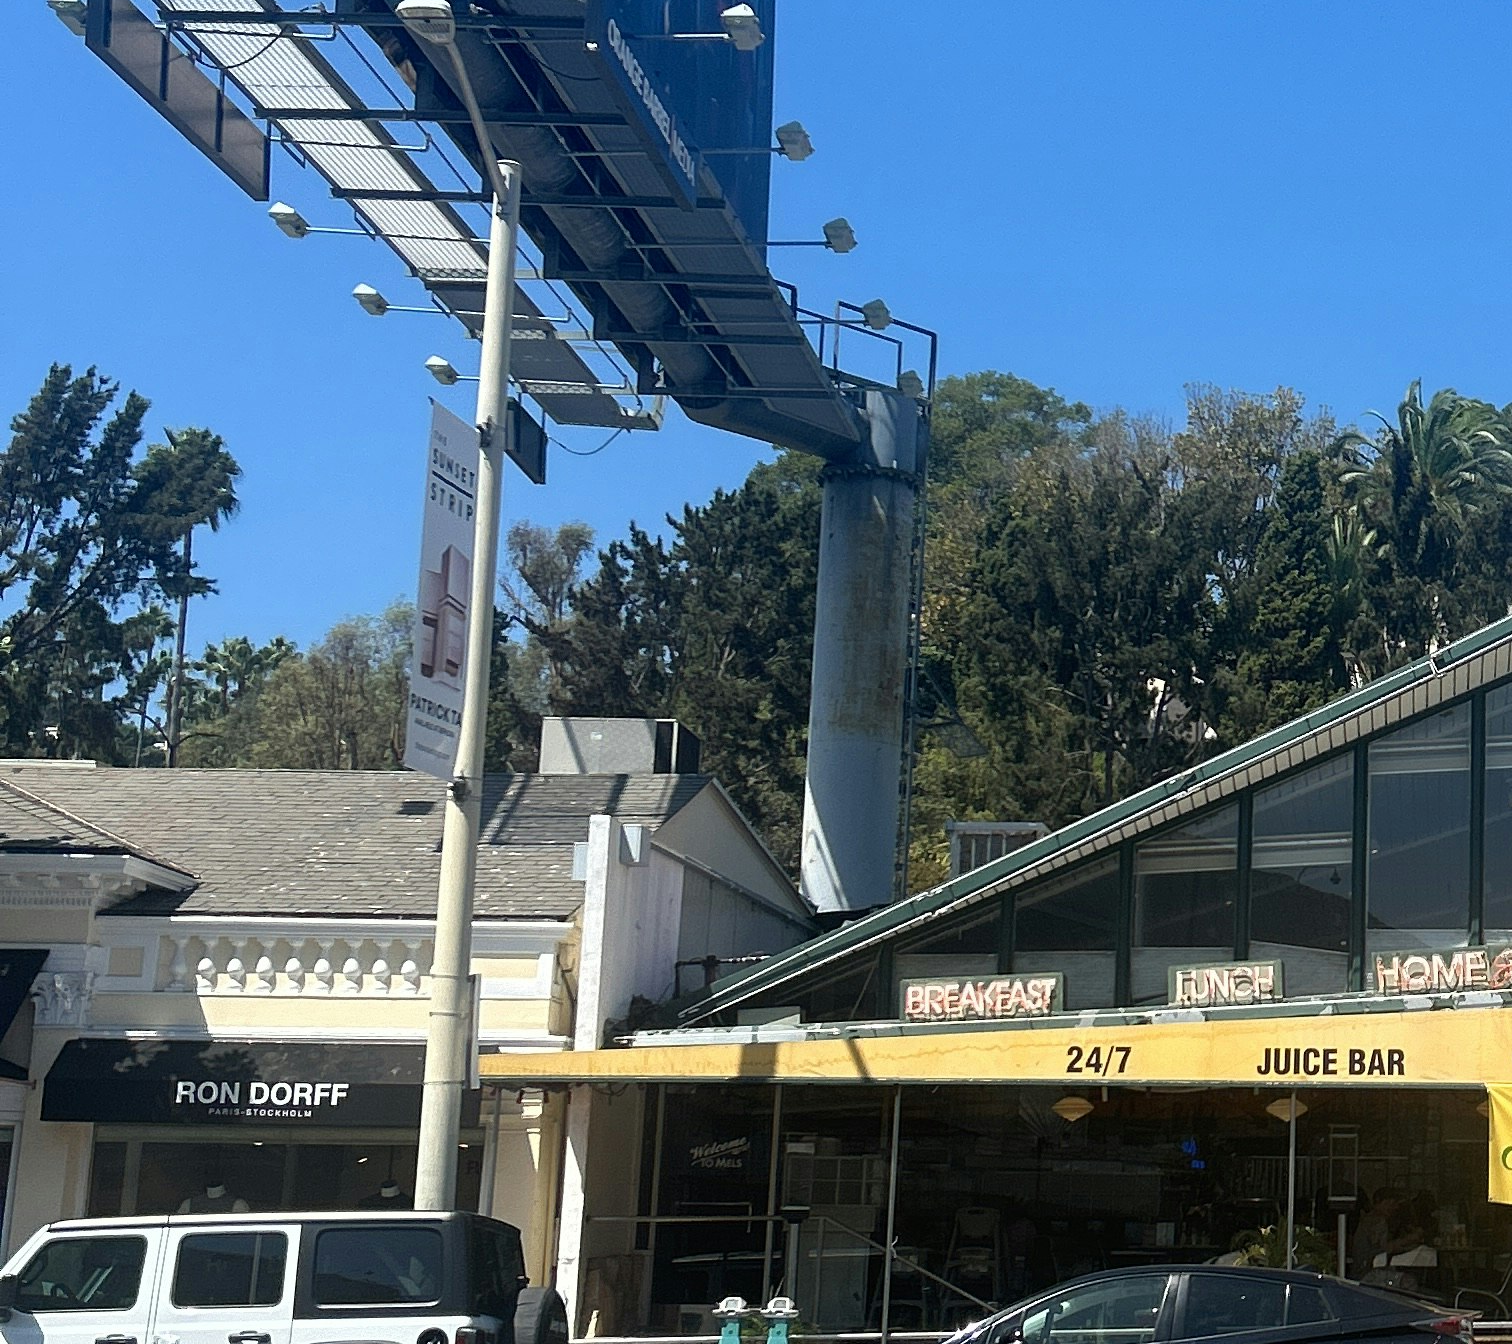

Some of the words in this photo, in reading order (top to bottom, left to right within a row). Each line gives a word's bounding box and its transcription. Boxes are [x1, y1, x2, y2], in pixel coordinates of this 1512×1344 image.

[433, 448, 475, 488] SUNSET
[430, 482, 474, 521] STRIP
[1175, 966, 1275, 1004] LUNCH
[1376, 950, 1488, 994] HOME
[905, 977, 1057, 1020] BREAKFAST
[1066, 1046, 1133, 1074] 24/7
[1257, 1048, 1338, 1075] JUICE
[1348, 1049, 1405, 1076] BAR
[175, 1081, 241, 1104] RON
[249, 1082, 350, 1106] DORFF
[690, 1137, 748, 1159] Welcome
[701, 1158, 714, 1168] TO
[715, 1158, 742, 1168] MELS
